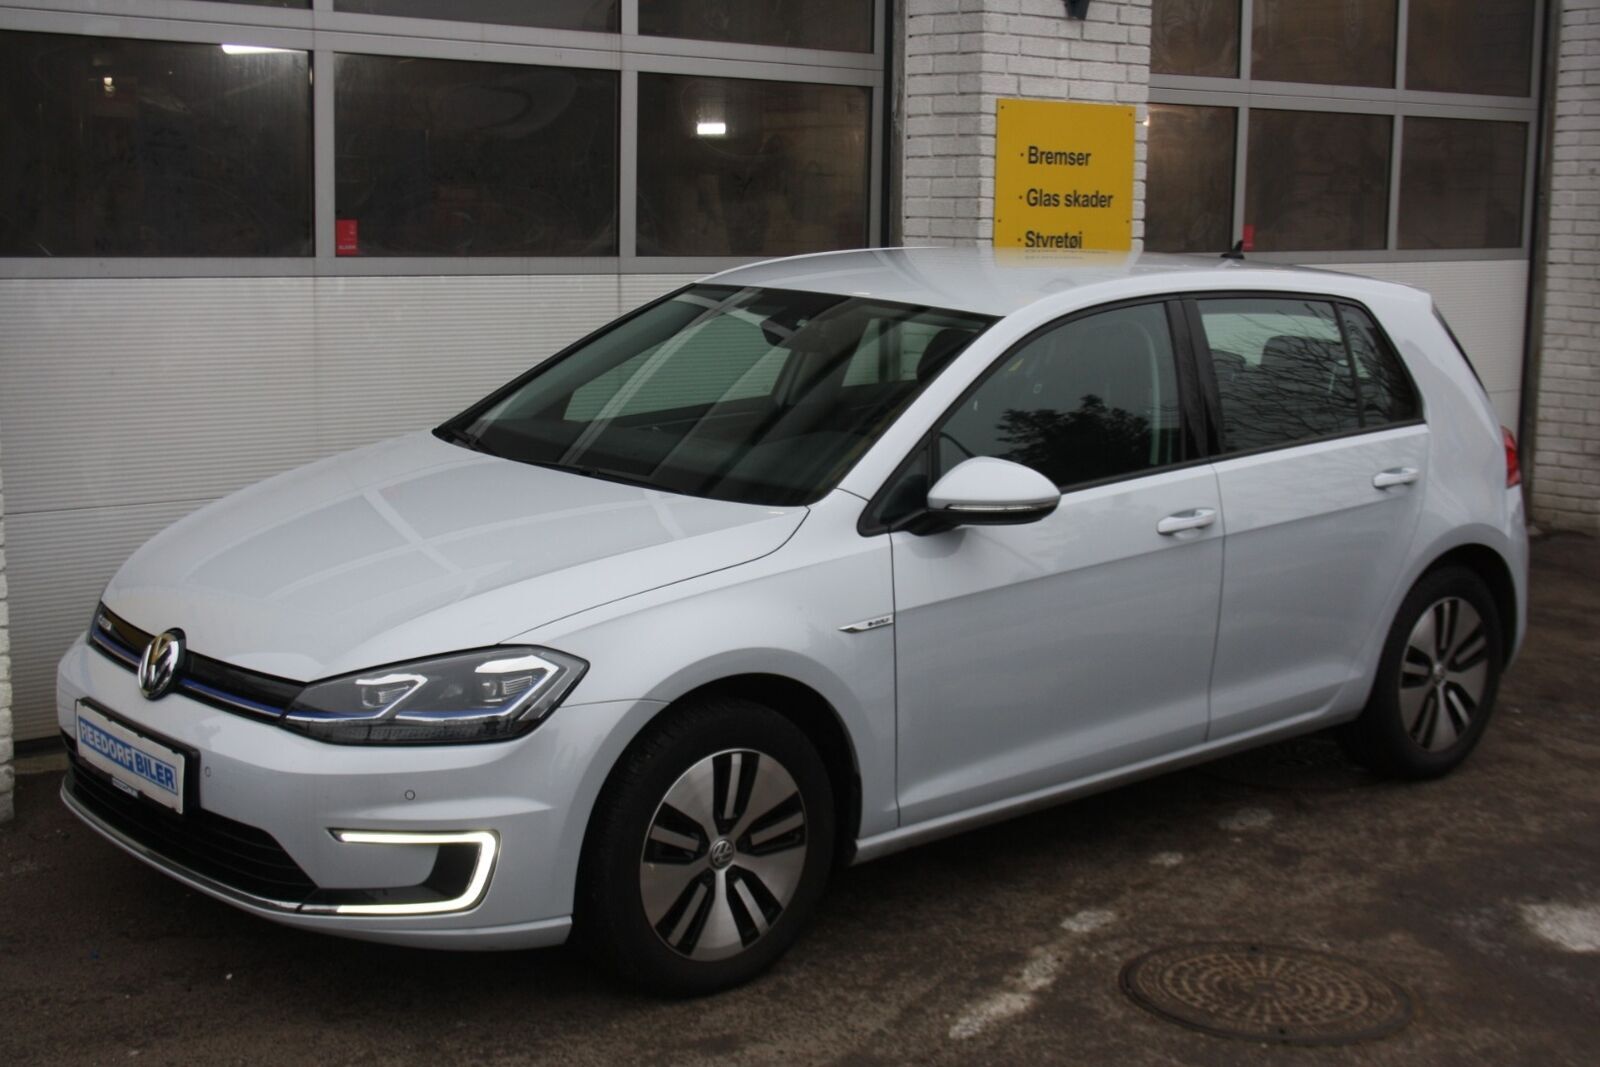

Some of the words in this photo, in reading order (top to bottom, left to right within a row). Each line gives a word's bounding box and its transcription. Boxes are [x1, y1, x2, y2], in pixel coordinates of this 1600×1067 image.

[1028, 146, 1091, 166] Bremser
[1026, 188, 1060, 207] Glas
[1064, 190, 1113, 208] skader
[135, 751, 175, 790] BILER
